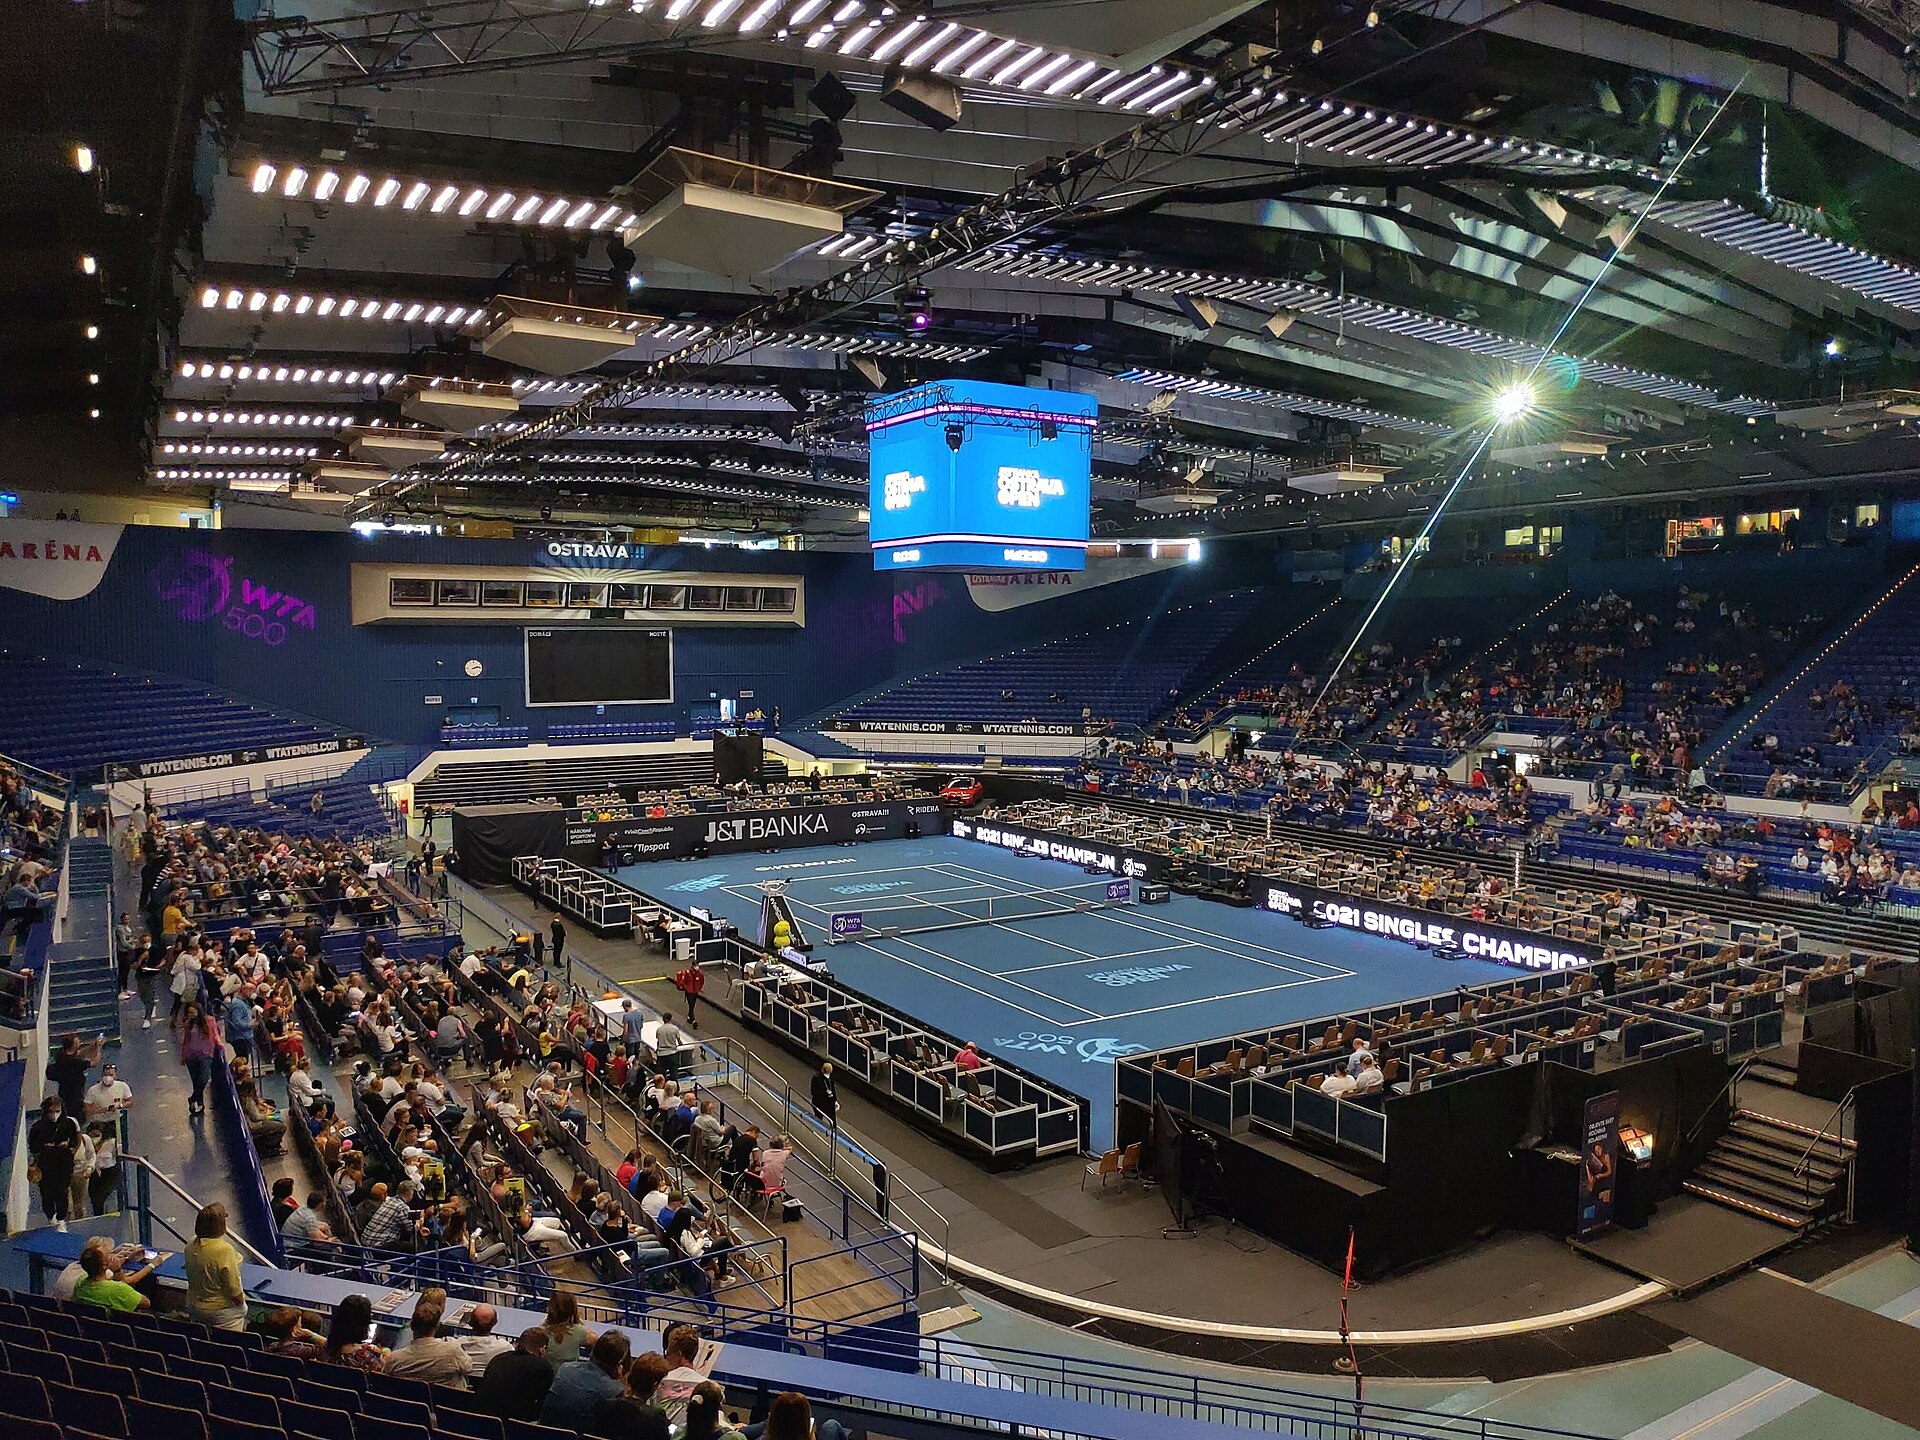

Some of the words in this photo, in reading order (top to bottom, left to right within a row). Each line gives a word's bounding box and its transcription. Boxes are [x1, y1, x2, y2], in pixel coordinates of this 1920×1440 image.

[0, 539, 103, 562] ARÉNA
[547, 542, 645, 560] OSTRAVA!!!
[241, 578, 317, 630] WTA
[223, 605, 287, 646] 500
[859, 721, 946, 732] WTATENNIS.COM
[982, 724, 1074, 734] WTATENNIS.COM
[265, 740, 340, 759] WTATENNIS.COM
[140, 753, 234, 776] WTATENNIS.COM
[851, 809, 890, 818] OSTRAVA!!!
[915, 805, 940, 814] RIDERA
[704, 819, 746, 843] J&T
[749, 813, 829, 839] BANKA
[976, 826, 1001, 845] 2021
[637, 841, 670, 854] Tipsport
[847, 917, 861, 925] WTA
[1313, 900, 1360, 927] 2021
[1363, 911, 1459, 949] SINGLES
[993, 1036, 1067, 1055] WTA
[1018, 1031, 1075, 1045] 500
